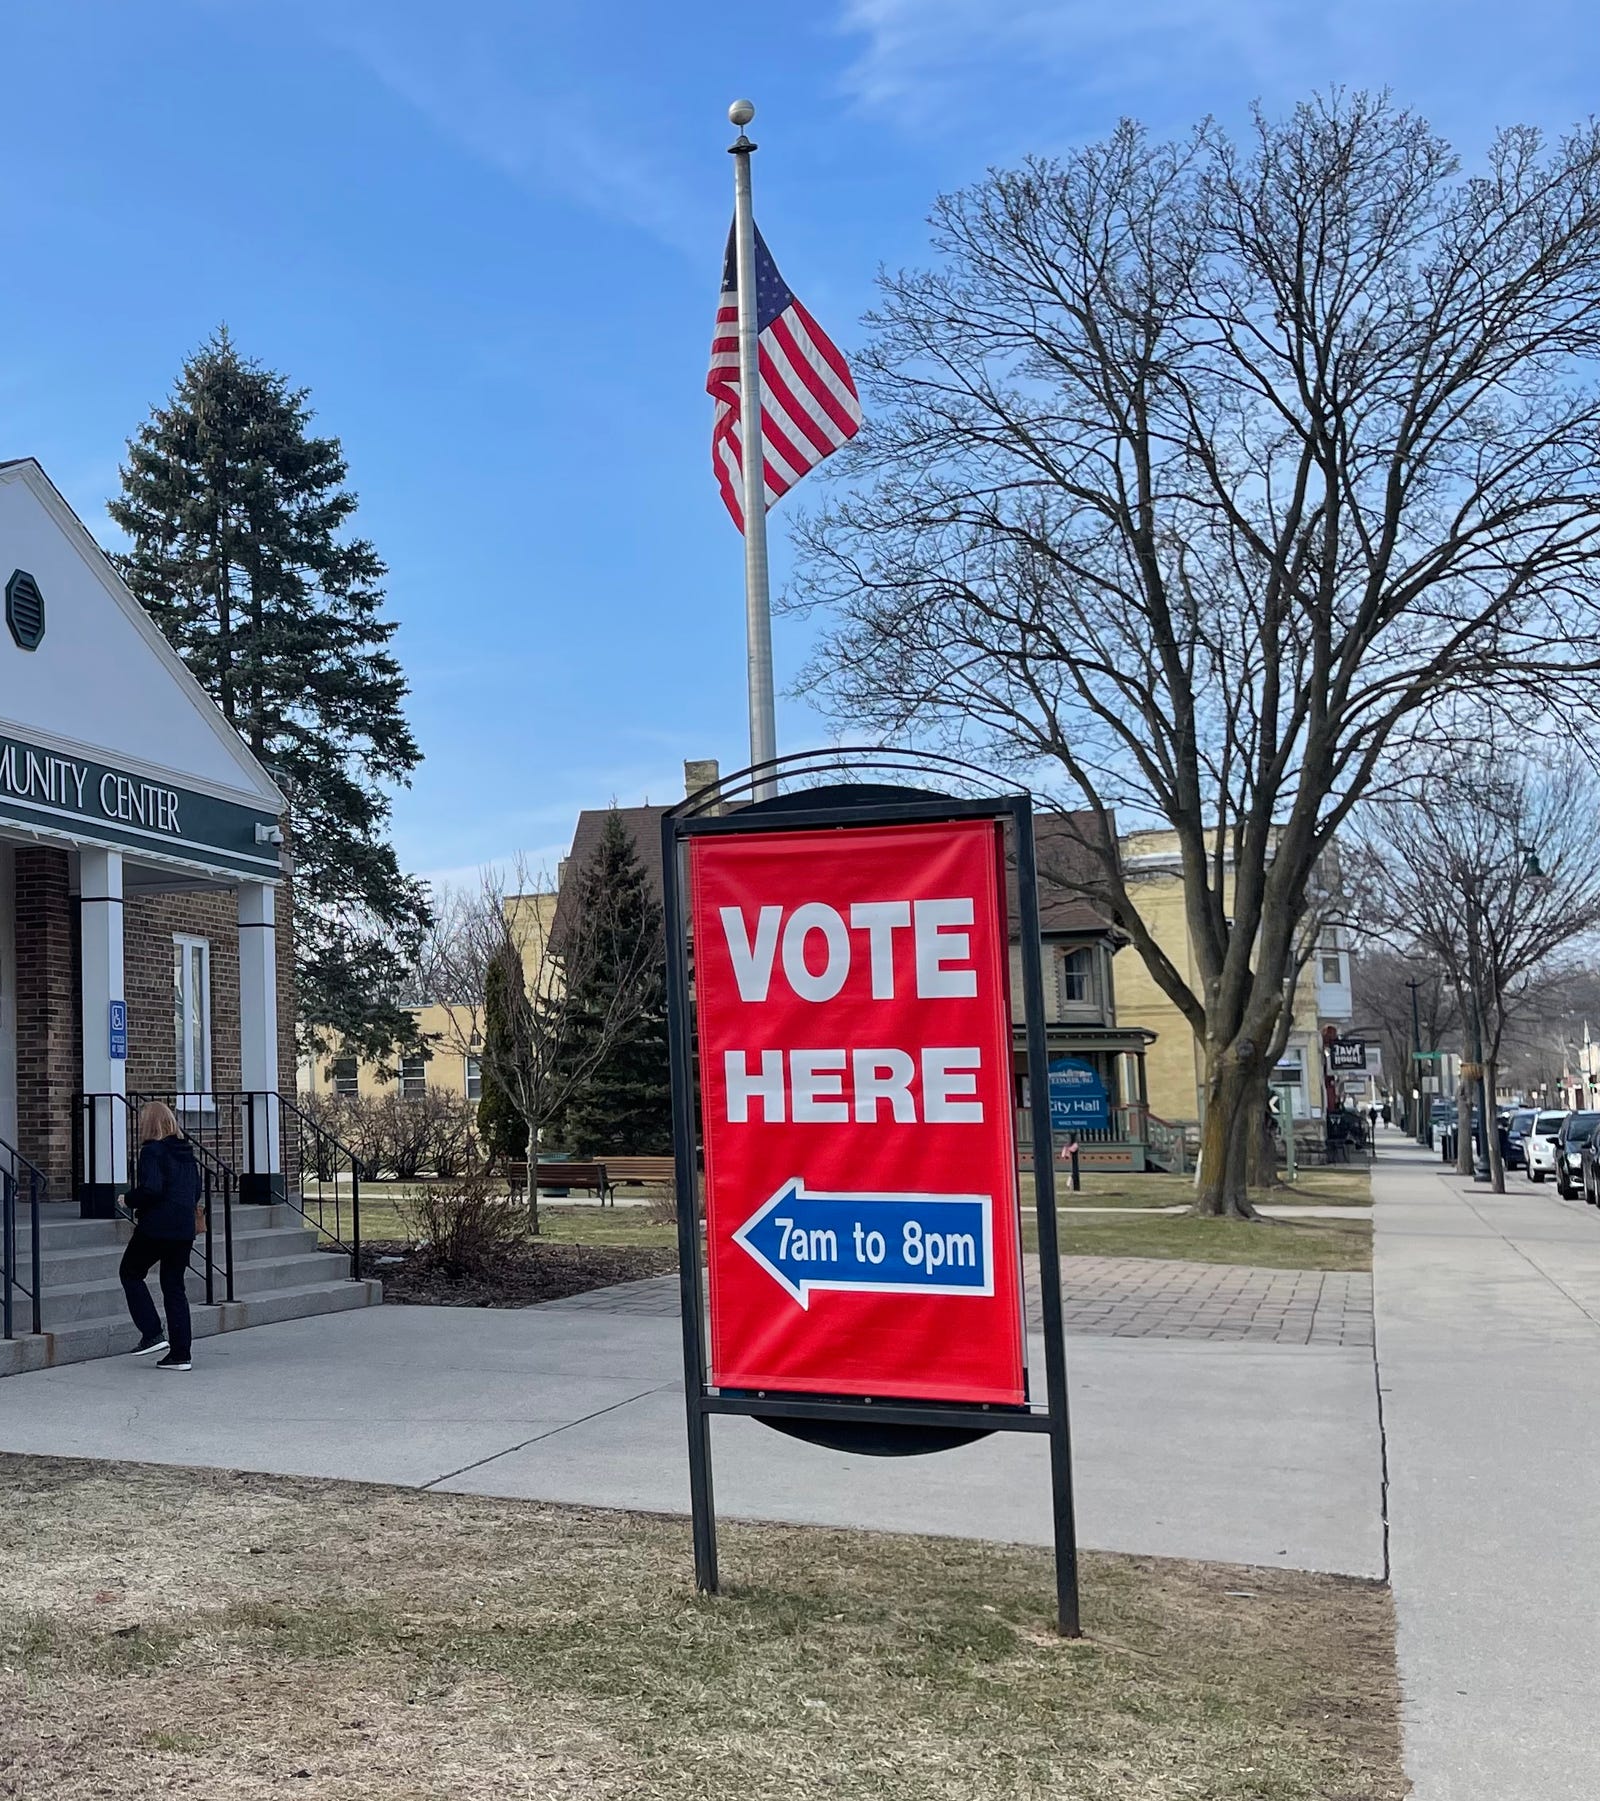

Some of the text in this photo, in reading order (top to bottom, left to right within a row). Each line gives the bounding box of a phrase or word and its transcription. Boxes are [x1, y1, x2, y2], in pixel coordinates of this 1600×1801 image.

[100, 772, 182, 833] CENTER
[719, 898, 977, 1003] VOTE
[1334, 1044, 1361, 1056] JAVA
[724, 1047, 984, 1123] HERE
[1074, 1100, 1100, 1111] Hall
[774, 1218, 976, 1275] 7am to 8pm
